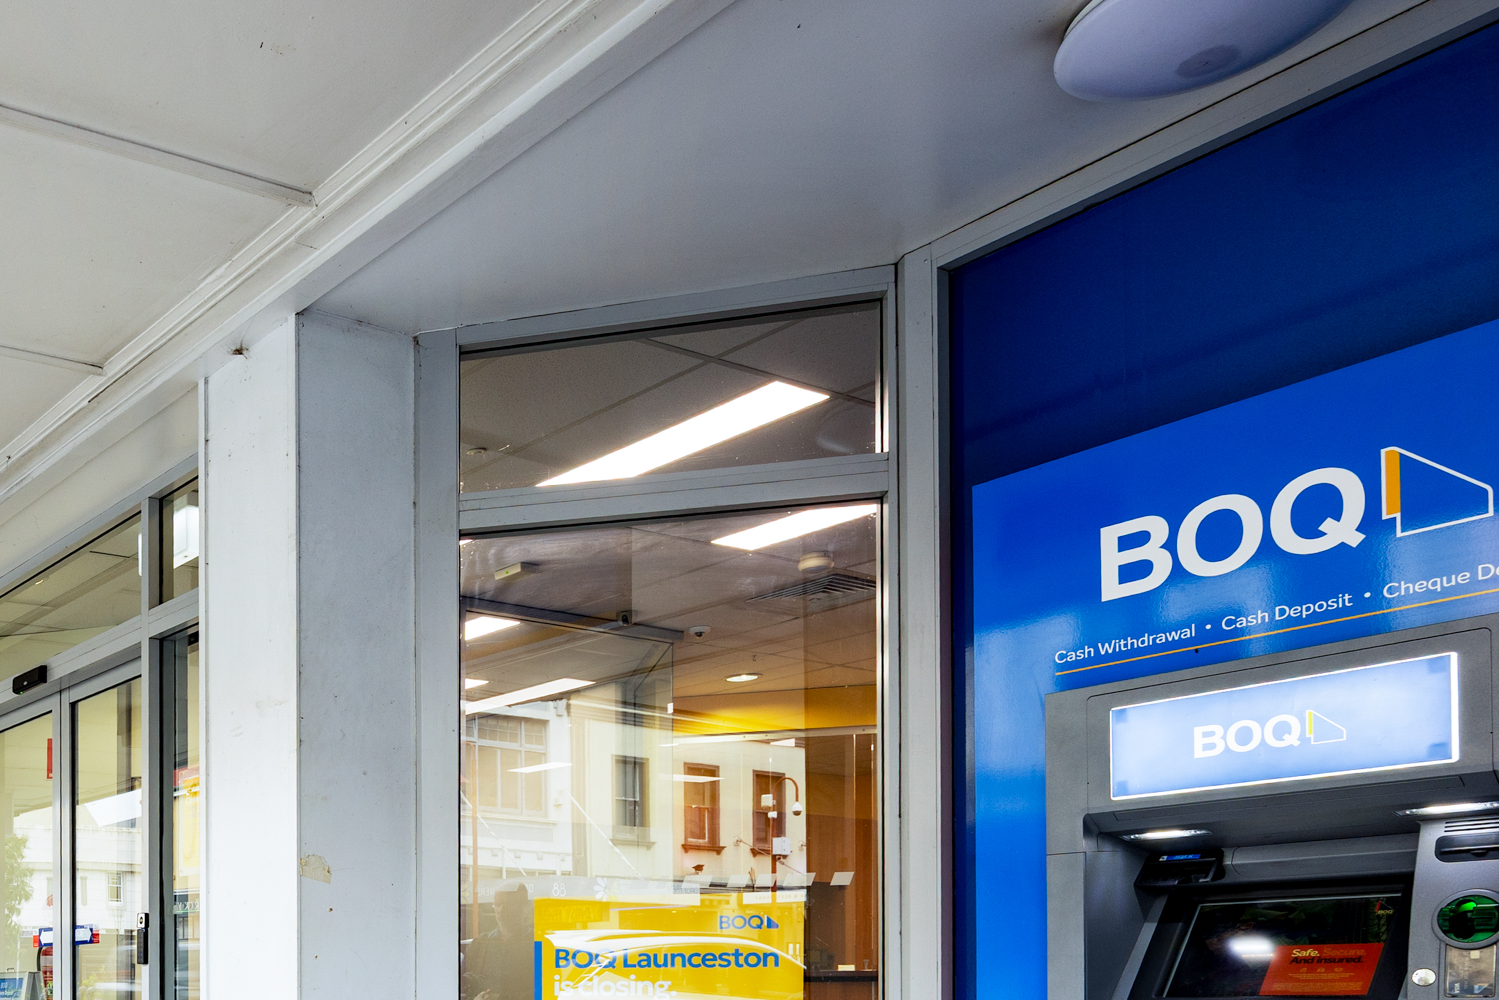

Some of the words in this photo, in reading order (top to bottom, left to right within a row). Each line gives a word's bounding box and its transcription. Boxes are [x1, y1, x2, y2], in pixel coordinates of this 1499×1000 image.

[1101, 467, 1366, 602] BOQ
[1383, 570, 1470, 600] Cheque
[1221, 611, 1269, 631] Cash
[1275, 593, 1353, 622] Deposit
[1055, 645, 1095, 664] Cash
[1097, 624, 1196, 657] Withdrawal
[1194, 714, 1301, 759] BOQ
[719, 915, 764, 929] BOQ
[555, 948, 617, 969] BOQ
[623, 948, 780, 968] Launceston
[1291, 949, 1320, 957] Safe.
[1323, 948, 1366, 956] Secure.
[554, 974, 573, 996] is
[578, 974, 678, 1000] closing.
